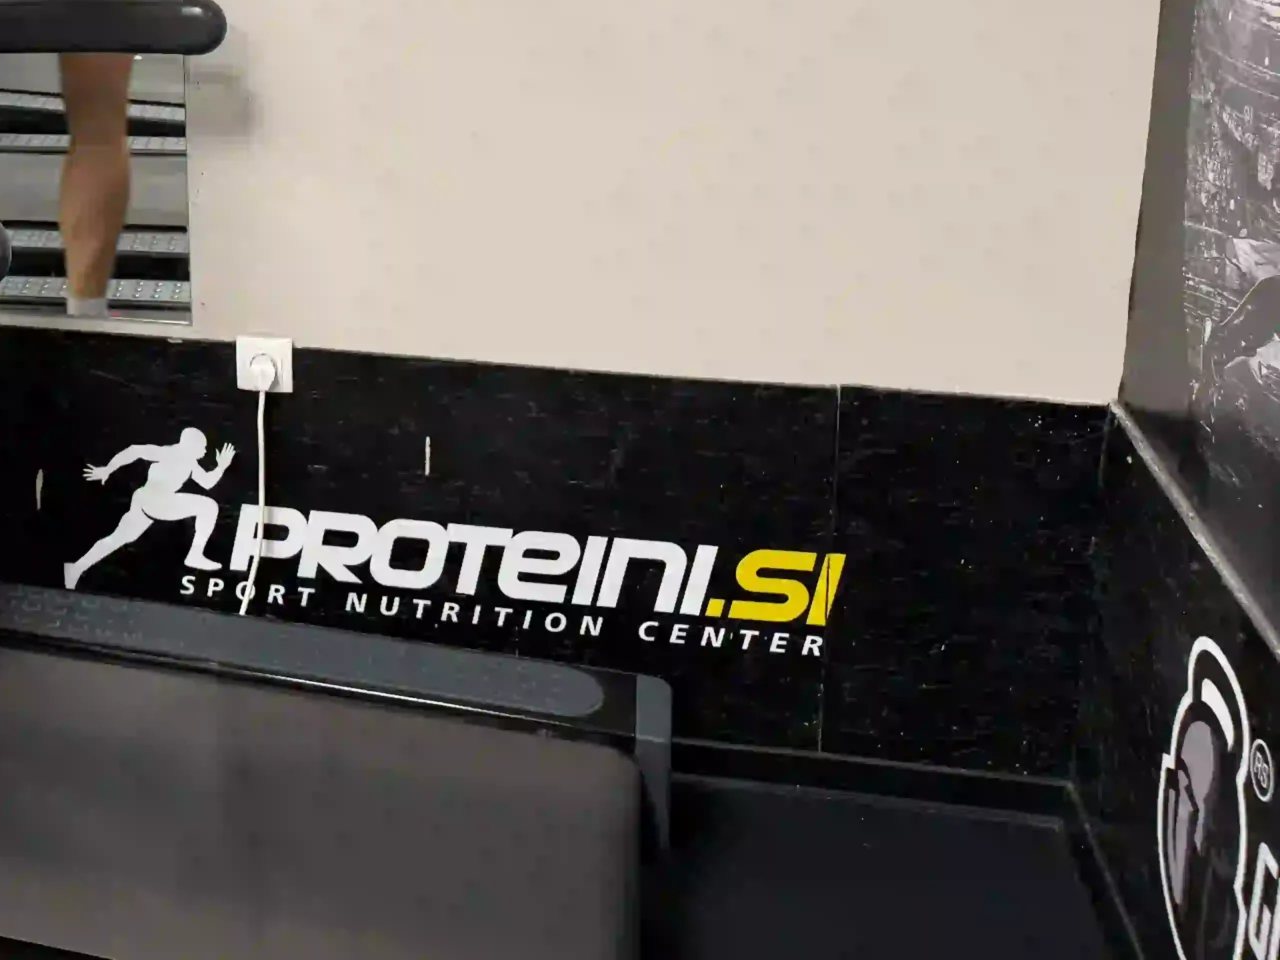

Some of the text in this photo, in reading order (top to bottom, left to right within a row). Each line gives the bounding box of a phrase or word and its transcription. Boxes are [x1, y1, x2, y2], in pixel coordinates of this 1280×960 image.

[180, 575, 824, 657] SPORT NUTRITION CENTER
